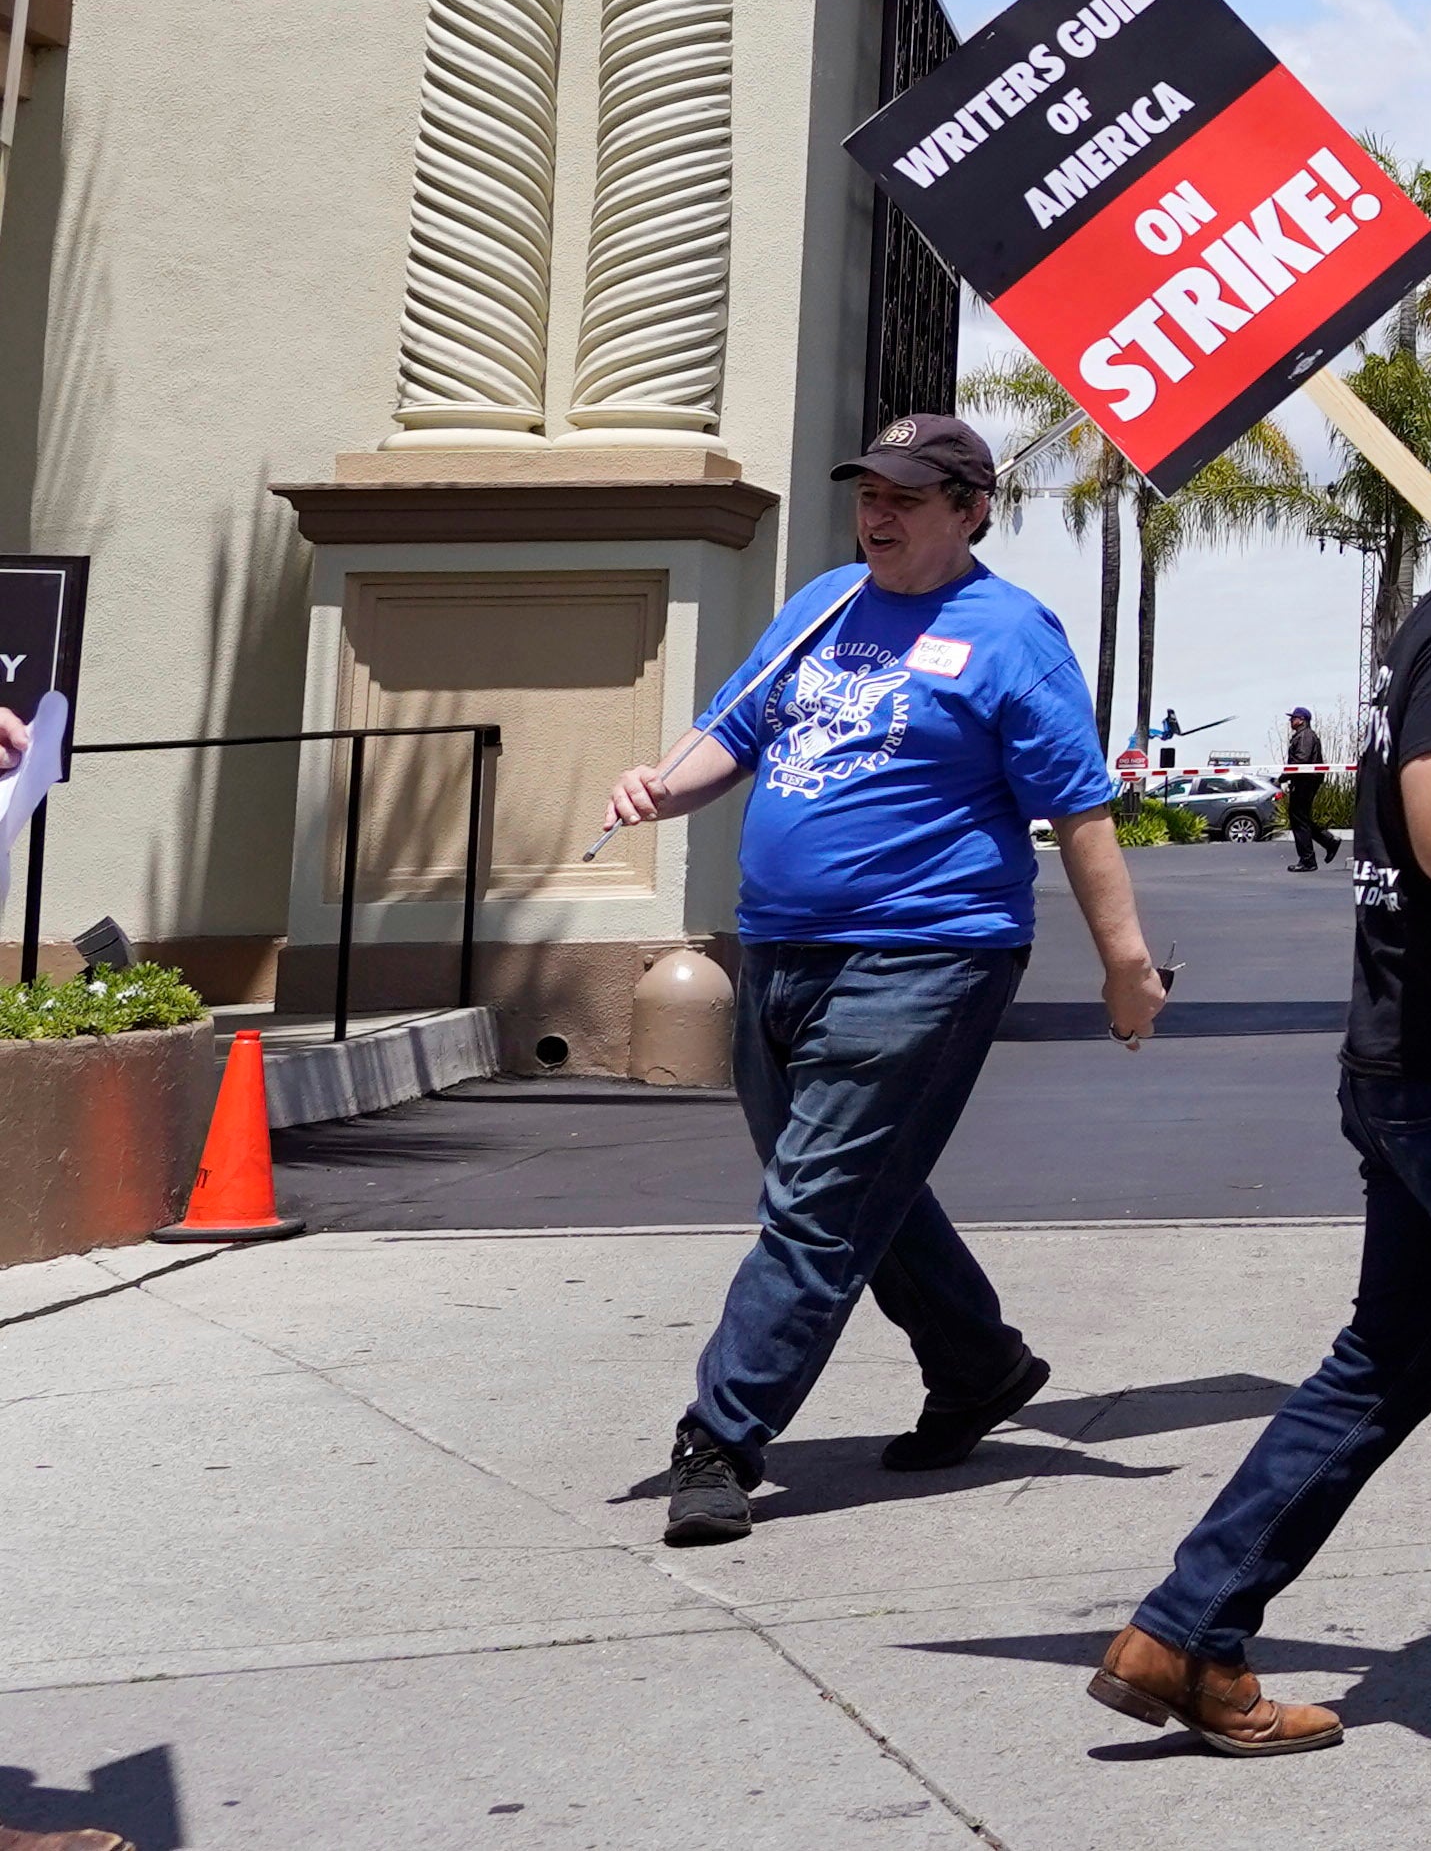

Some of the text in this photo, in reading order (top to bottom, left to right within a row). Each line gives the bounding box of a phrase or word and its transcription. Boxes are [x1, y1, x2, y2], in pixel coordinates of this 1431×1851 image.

[893, 44, 1065, 188] WRITERS
[1047, 88, 1092, 134] OF
[1024, 82, 1195, 229] AMERICA
[1135, 180, 1217, 255] ON
[1079, 147, 1380, 422] STRIKE!
[885, 429, 910, 443] 89
[0, 654, 28, 683] Y
[820, 642, 879, 661] GUILD
[876, 649, 899, 669] OF
[764, 670, 796, 736] RITERS
[861, 692, 910, 772] AMERICA
[781, 772, 809, 788] WEST
